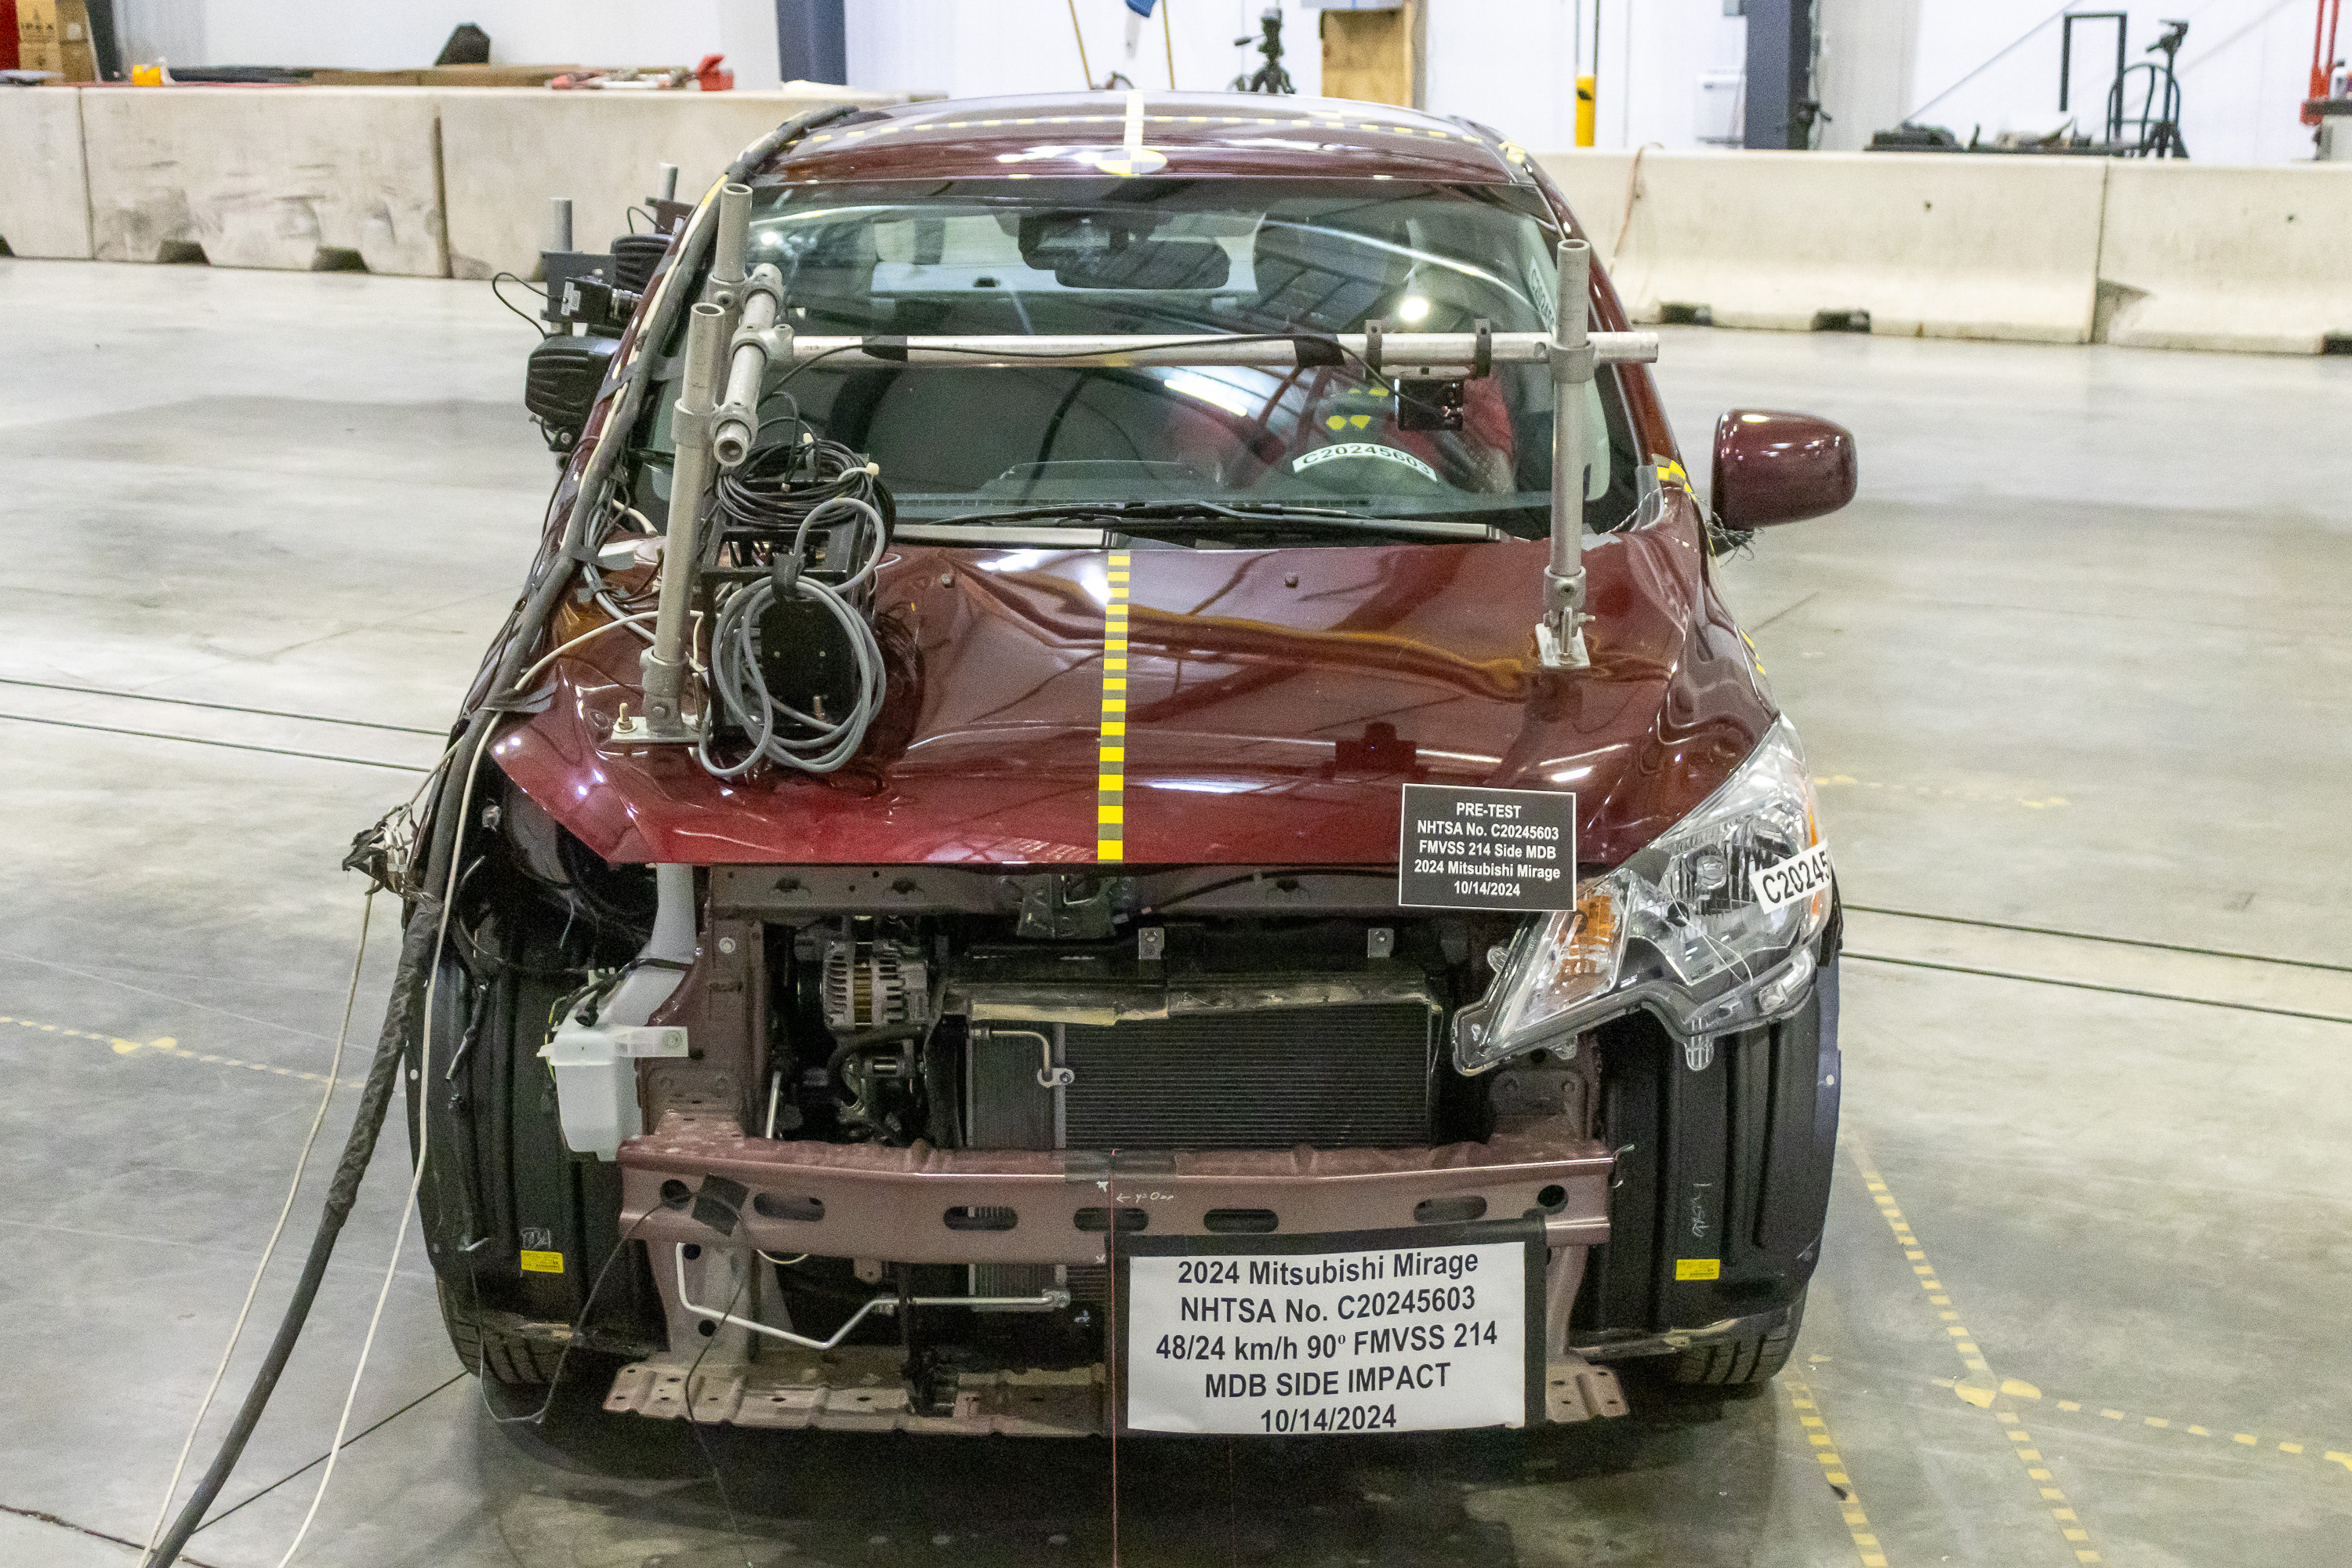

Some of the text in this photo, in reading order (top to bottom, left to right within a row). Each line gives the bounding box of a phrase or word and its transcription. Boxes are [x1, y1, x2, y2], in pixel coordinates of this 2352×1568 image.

[1302, 444, 1431, 475] C20245603
[1456, 801, 1523, 818] PRE-TEST
[1417, 819, 1559, 840] NHTSA No. C20245603
[1419, 839, 1557, 860] FMVSS 214 Side MDB
[1414, 858, 1561, 882] 2024 Mitsubishi Mirage
[1454, 880, 1521, 897] 10/14/2024
[1178, 1252, 1479, 1286] 2024 Mitsubishi Mirage
[1181, 1285, 1475, 1323] NHTSA No. C20245603
[1156, 1334, 1225, 1360] 48/24
[1235, 1336, 1298, 1360] km/h
[1354, 1324, 1445, 1356] FMVSS
[1454, 1320, 1498, 1348] 214
[1205, 1362, 1452, 1398] MDB SIDE IMPACT
[1261, 1403, 1397, 1432] 10/14/2024
